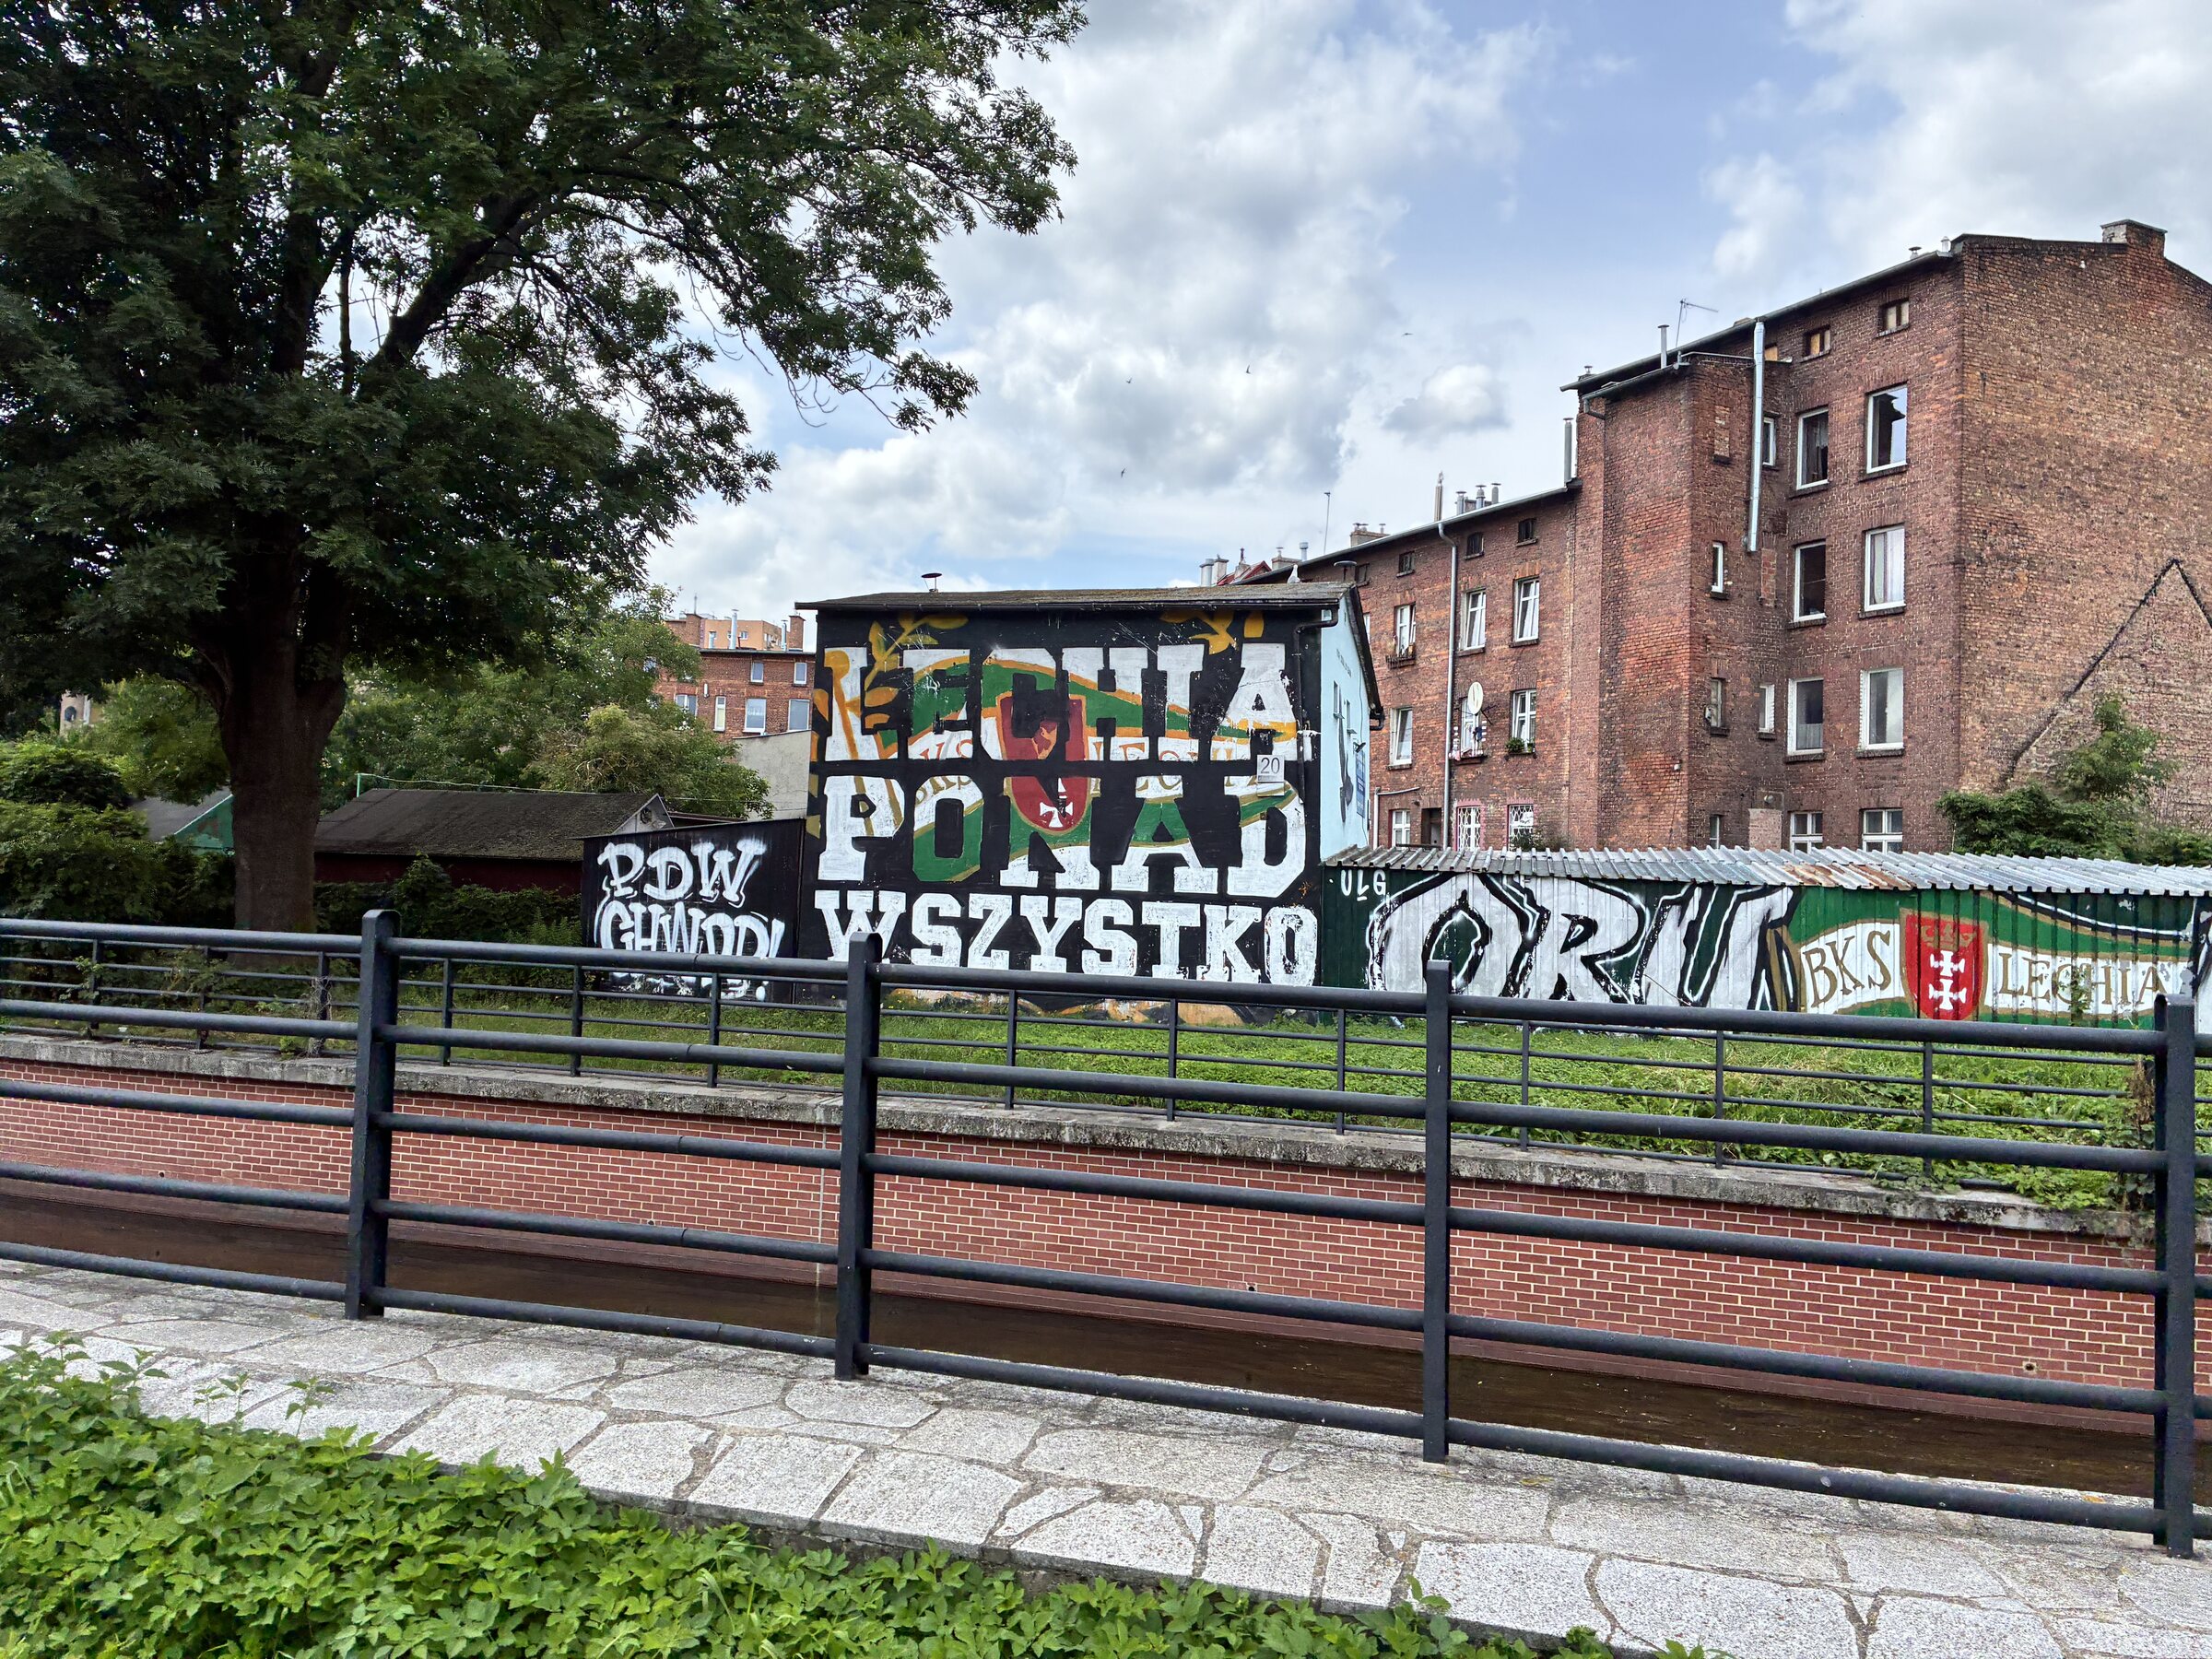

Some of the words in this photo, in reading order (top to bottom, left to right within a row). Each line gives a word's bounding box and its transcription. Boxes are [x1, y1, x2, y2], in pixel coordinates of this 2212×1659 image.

[825, 643, 1312, 761] LECHIA
[1261, 757, 1280, 774] 20
[597, 838, 768, 902] PDW
[818, 775, 1307, 899] PONAD
[814, 889, 1319, 987] WSZYSTKO
[1803, 930, 1891, 1008] BKS
[1998, 952, 2167, 1006] LECHIA
